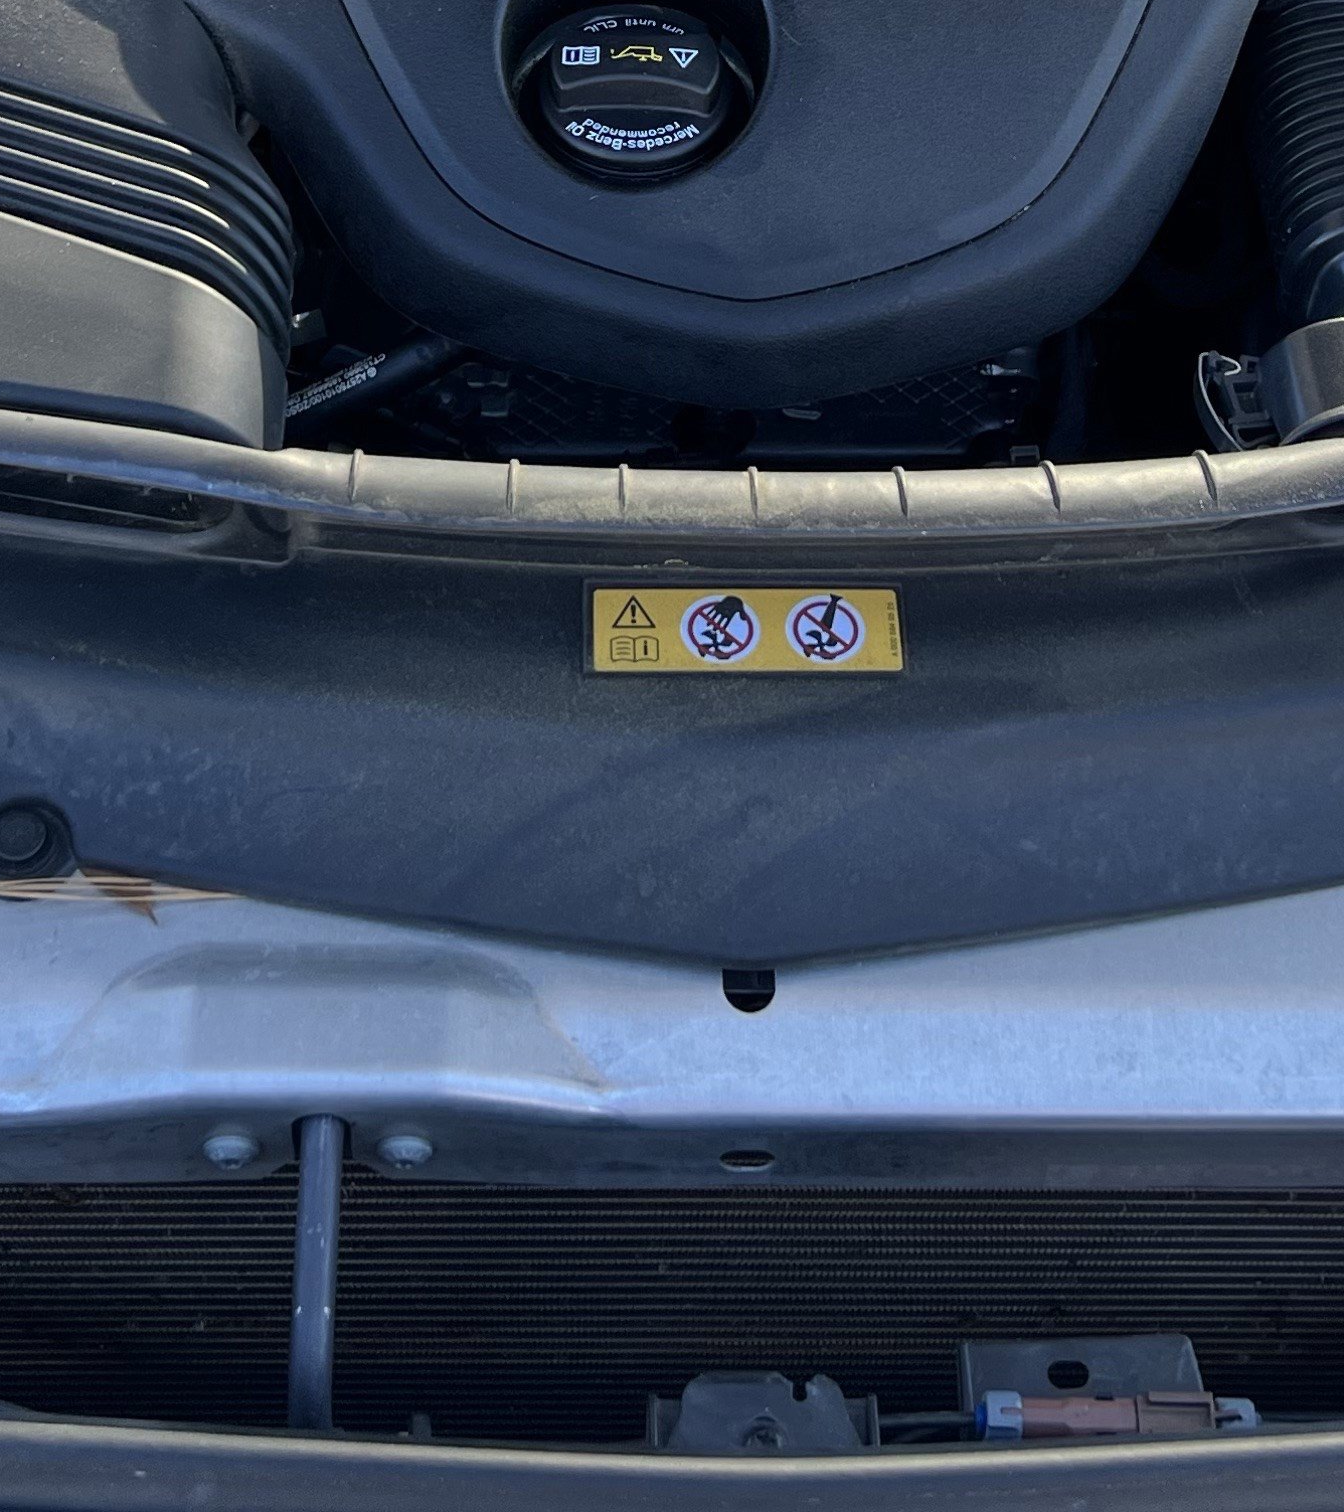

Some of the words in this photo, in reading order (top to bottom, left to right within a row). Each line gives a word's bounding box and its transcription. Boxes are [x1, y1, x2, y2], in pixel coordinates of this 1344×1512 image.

[565, 121, 585, 136] Oil
[582, 118, 681, 138] recommended
[586, 124, 700, 150] Mercedes-Benz
